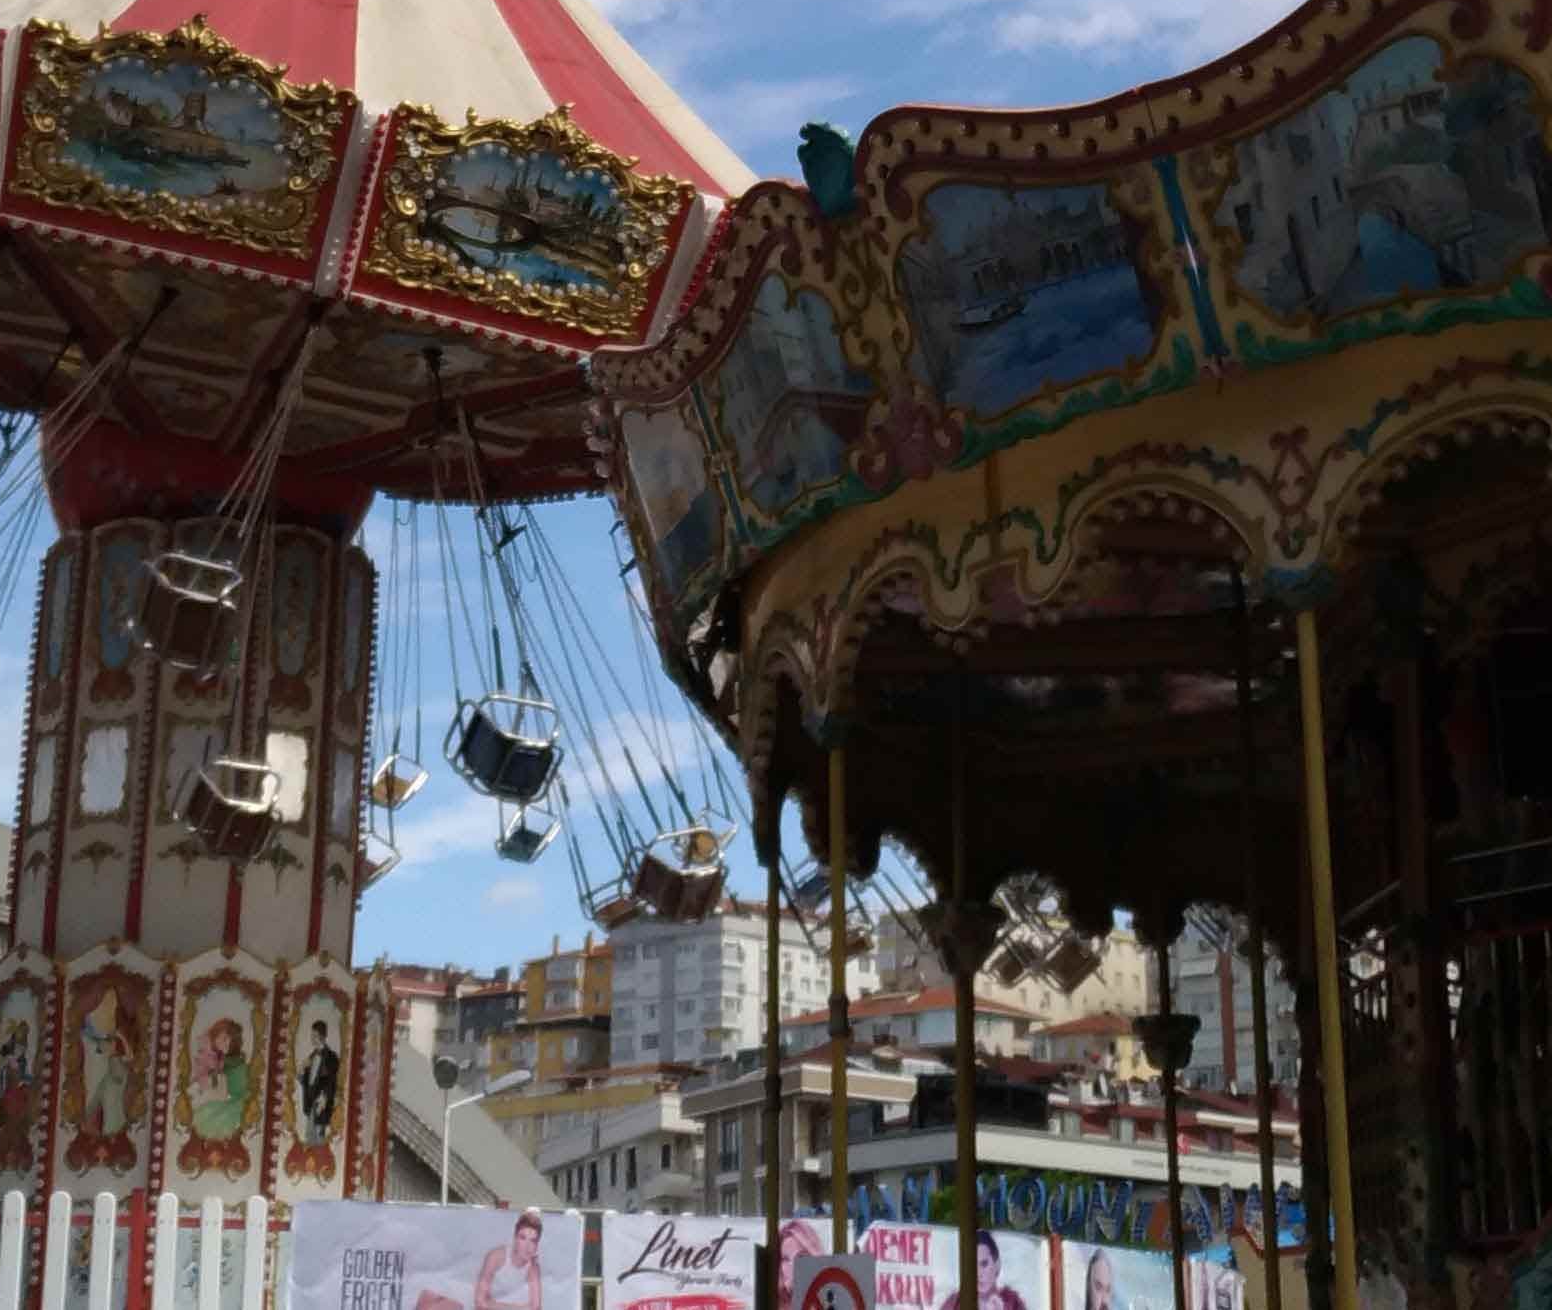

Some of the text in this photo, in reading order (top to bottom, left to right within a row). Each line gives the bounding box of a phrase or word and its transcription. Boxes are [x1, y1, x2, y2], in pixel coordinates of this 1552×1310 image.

[616, 1219, 749, 1284] Linet
[866, 1227, 932, 1266] DEMET
[340, 1280, 403, 1310] ERGEN
[875, 1272, 936, 1307] KALIN
